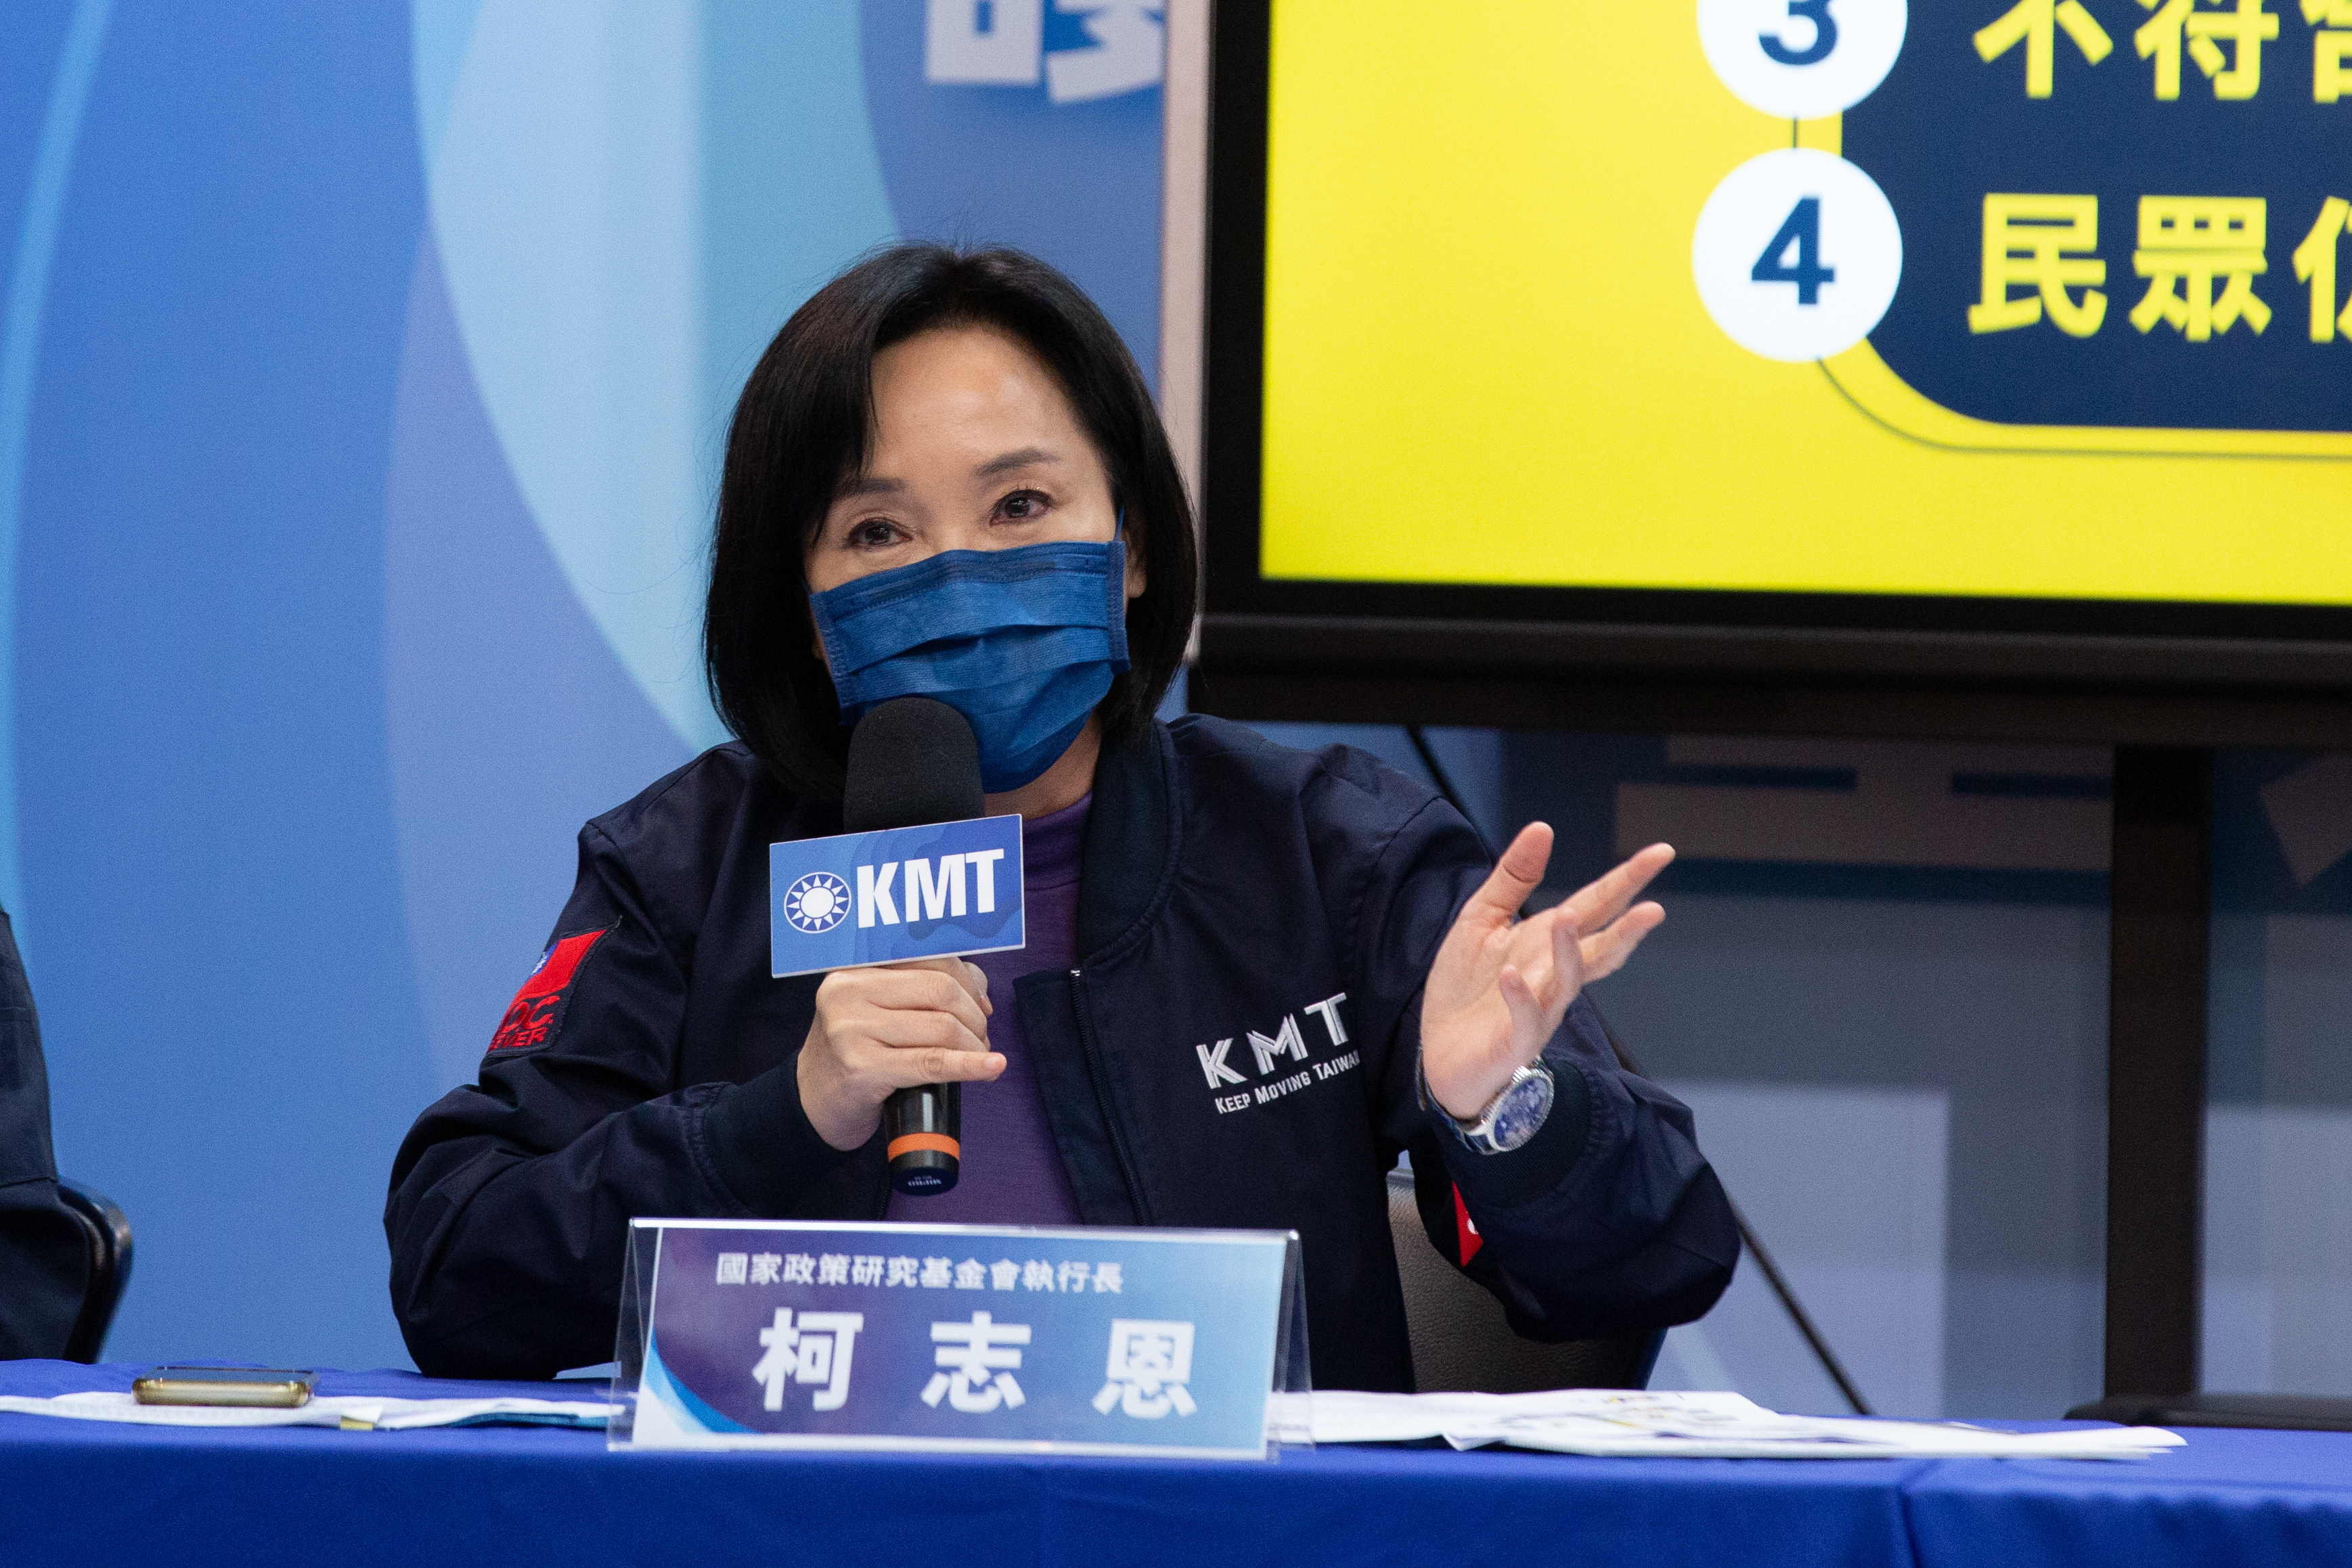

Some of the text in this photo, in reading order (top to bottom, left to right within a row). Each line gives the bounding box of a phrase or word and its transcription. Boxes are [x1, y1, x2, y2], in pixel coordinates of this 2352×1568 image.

[1972, 0, 2352, 102] 不符
[1751, 195, 1836, 305] 4
[857, 849, 1004, 928] KMT
[1195, 992, 1349, 1090] KMT
[1215, 1093, 1251, 1114] KEEP
[1254, 1071, 1312, 1104] MOVING
[717, 1251, 1124, 1294] 國家政策研究基金會執行長
[752, 1307, 1198, 1419] 柯志恩
